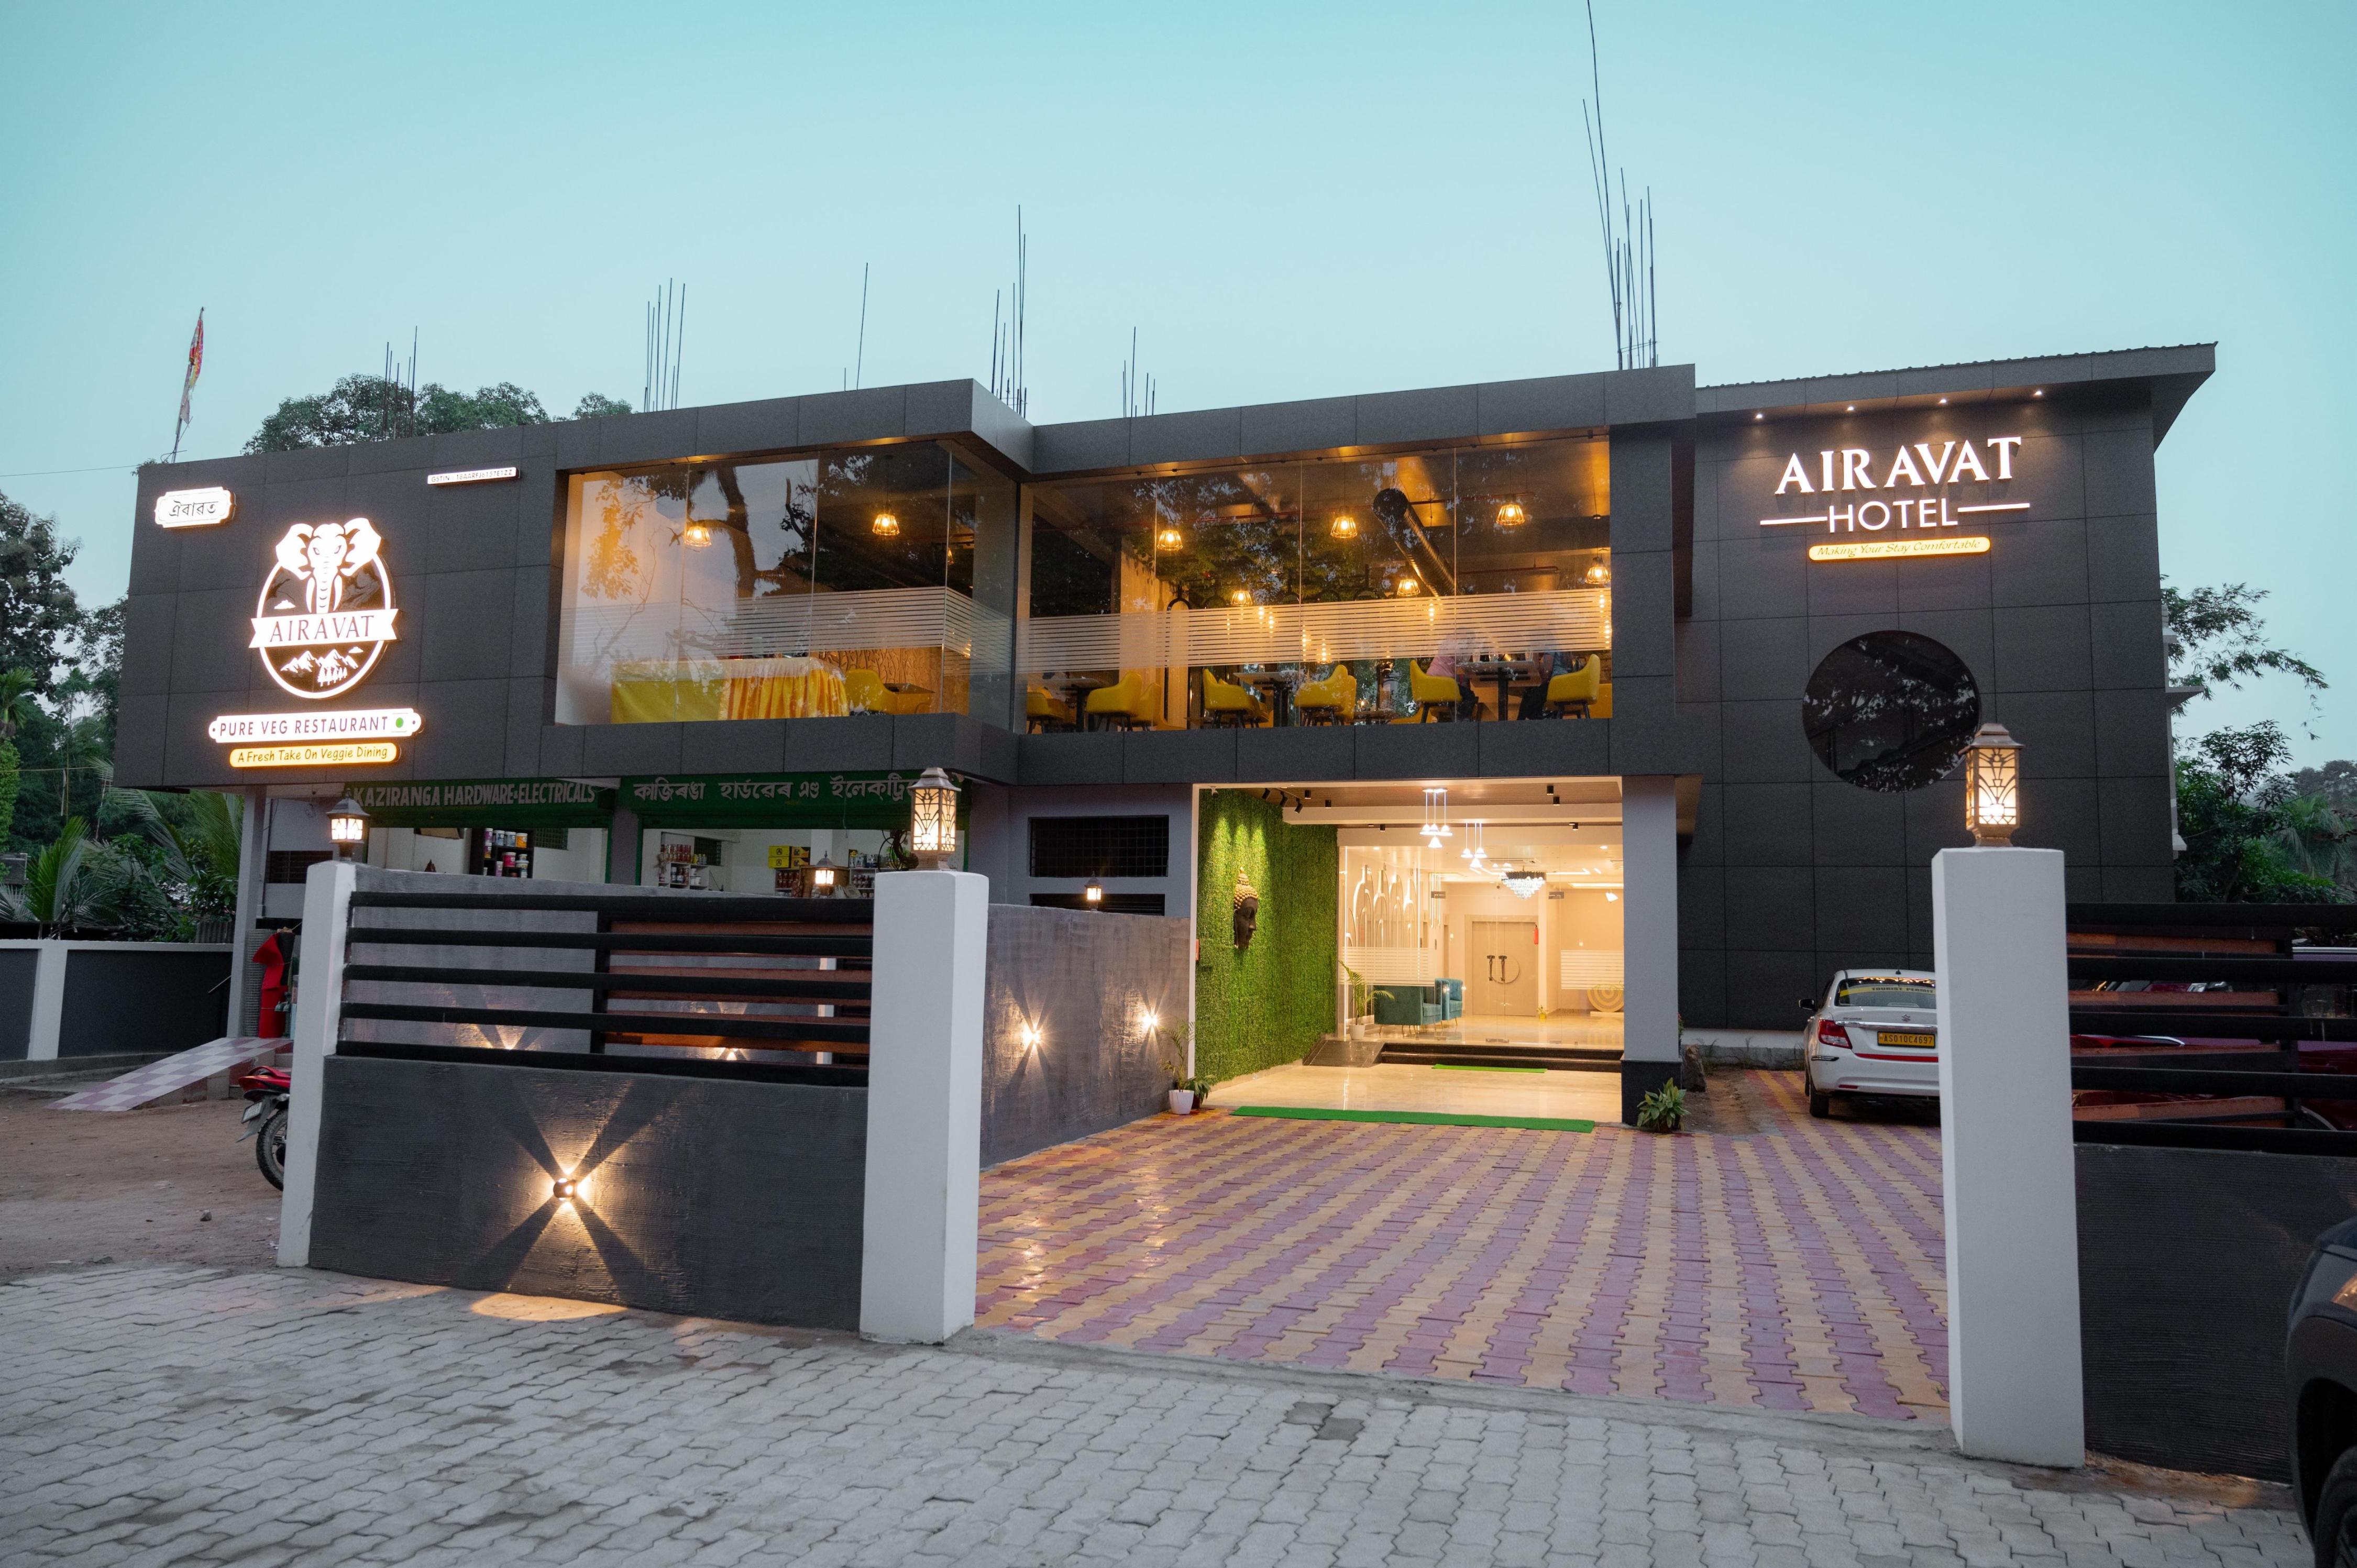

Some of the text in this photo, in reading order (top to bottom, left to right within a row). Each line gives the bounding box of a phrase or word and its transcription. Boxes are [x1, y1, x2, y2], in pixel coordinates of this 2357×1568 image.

[1775, 436, 2021, 494] AIRAVAT
[1829, 498, 1958, 533] HOTEL
[1817, 539, 1981, 558] Making Your Stay Comfortable
[269, 615, 374, 642] AIRAVAT
[220, 716, 388, 736] PURE VEG RESTAURANT
[237, 745, 388, 763] A Fresh Take On Veggie Dining
[354, 786, 440, 807] KAZIRANGA
